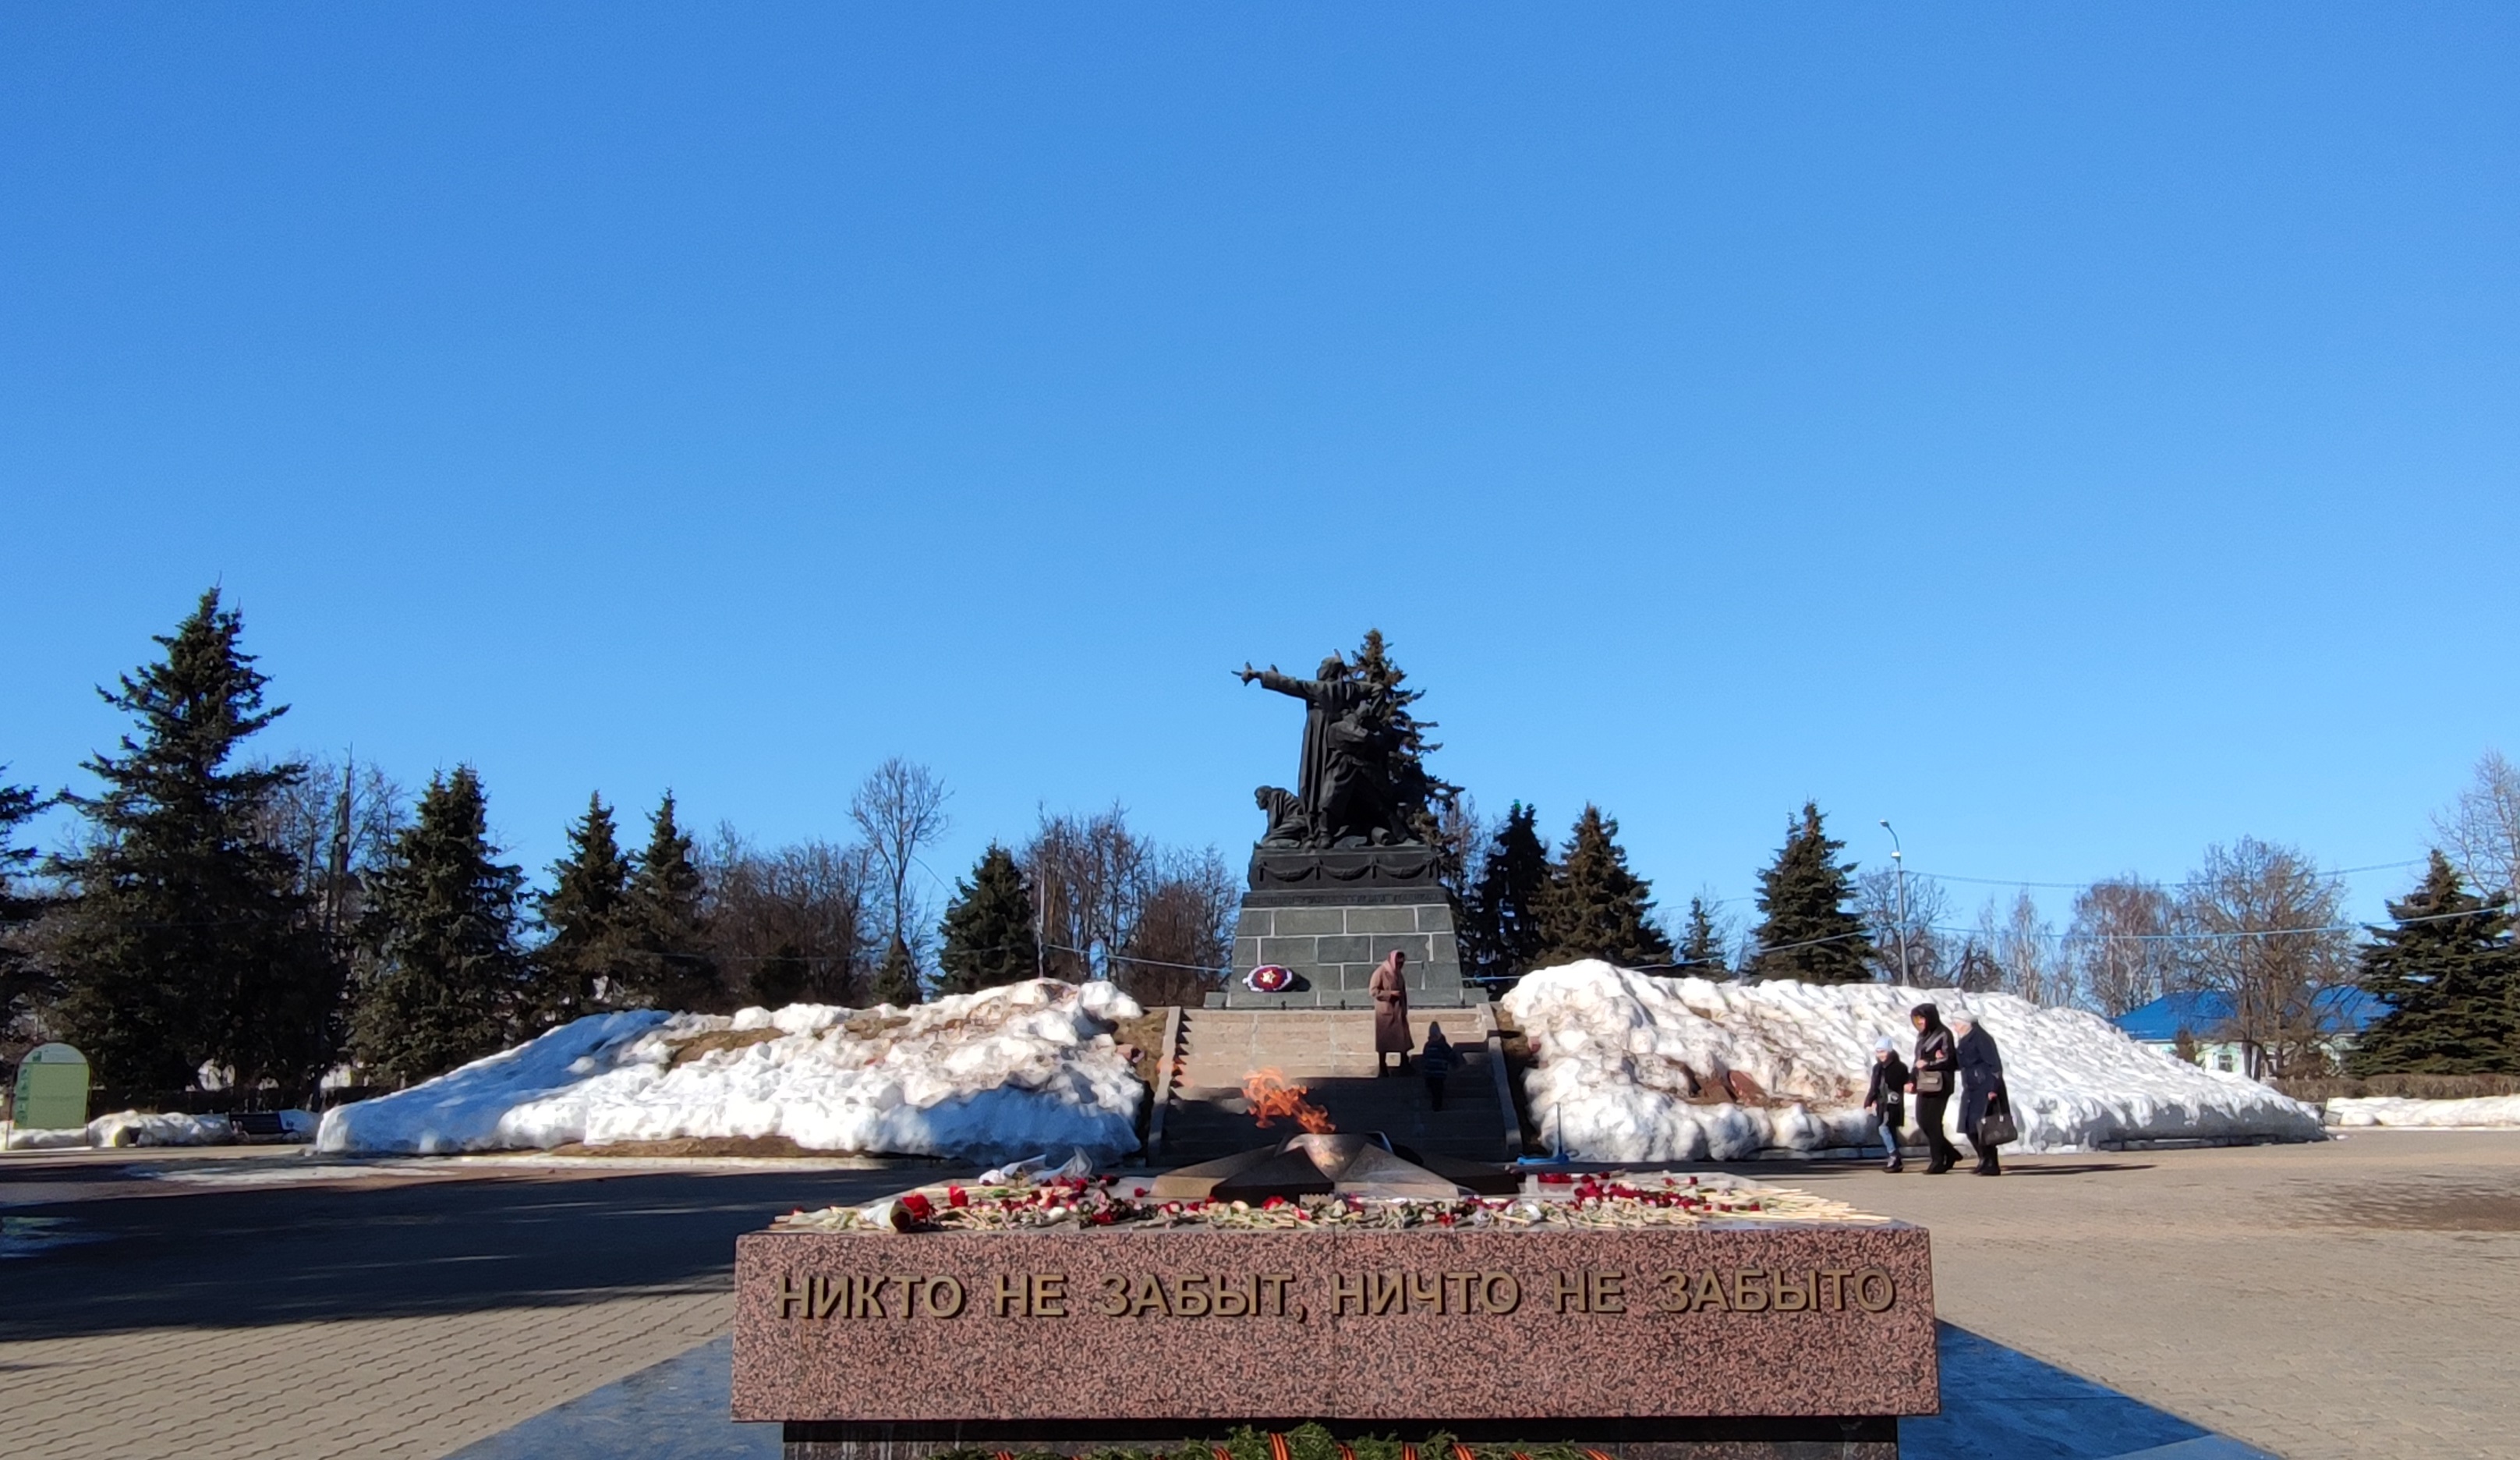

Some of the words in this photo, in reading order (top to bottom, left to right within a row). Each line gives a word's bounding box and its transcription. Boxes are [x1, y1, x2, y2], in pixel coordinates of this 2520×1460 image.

[780, 1274, 964, 1320] НИКТО
[994, 1273, 1067, 1318] НЕ
[1099, 1272, 1308, 1324] ЗАБЫТ,
[1331, 1270, 1520, 1315] НИЧТО
[1554, 1269, 1626, 1313] НЕ
[1658, 1268, 1896, 1312] ЗАБЫТО
